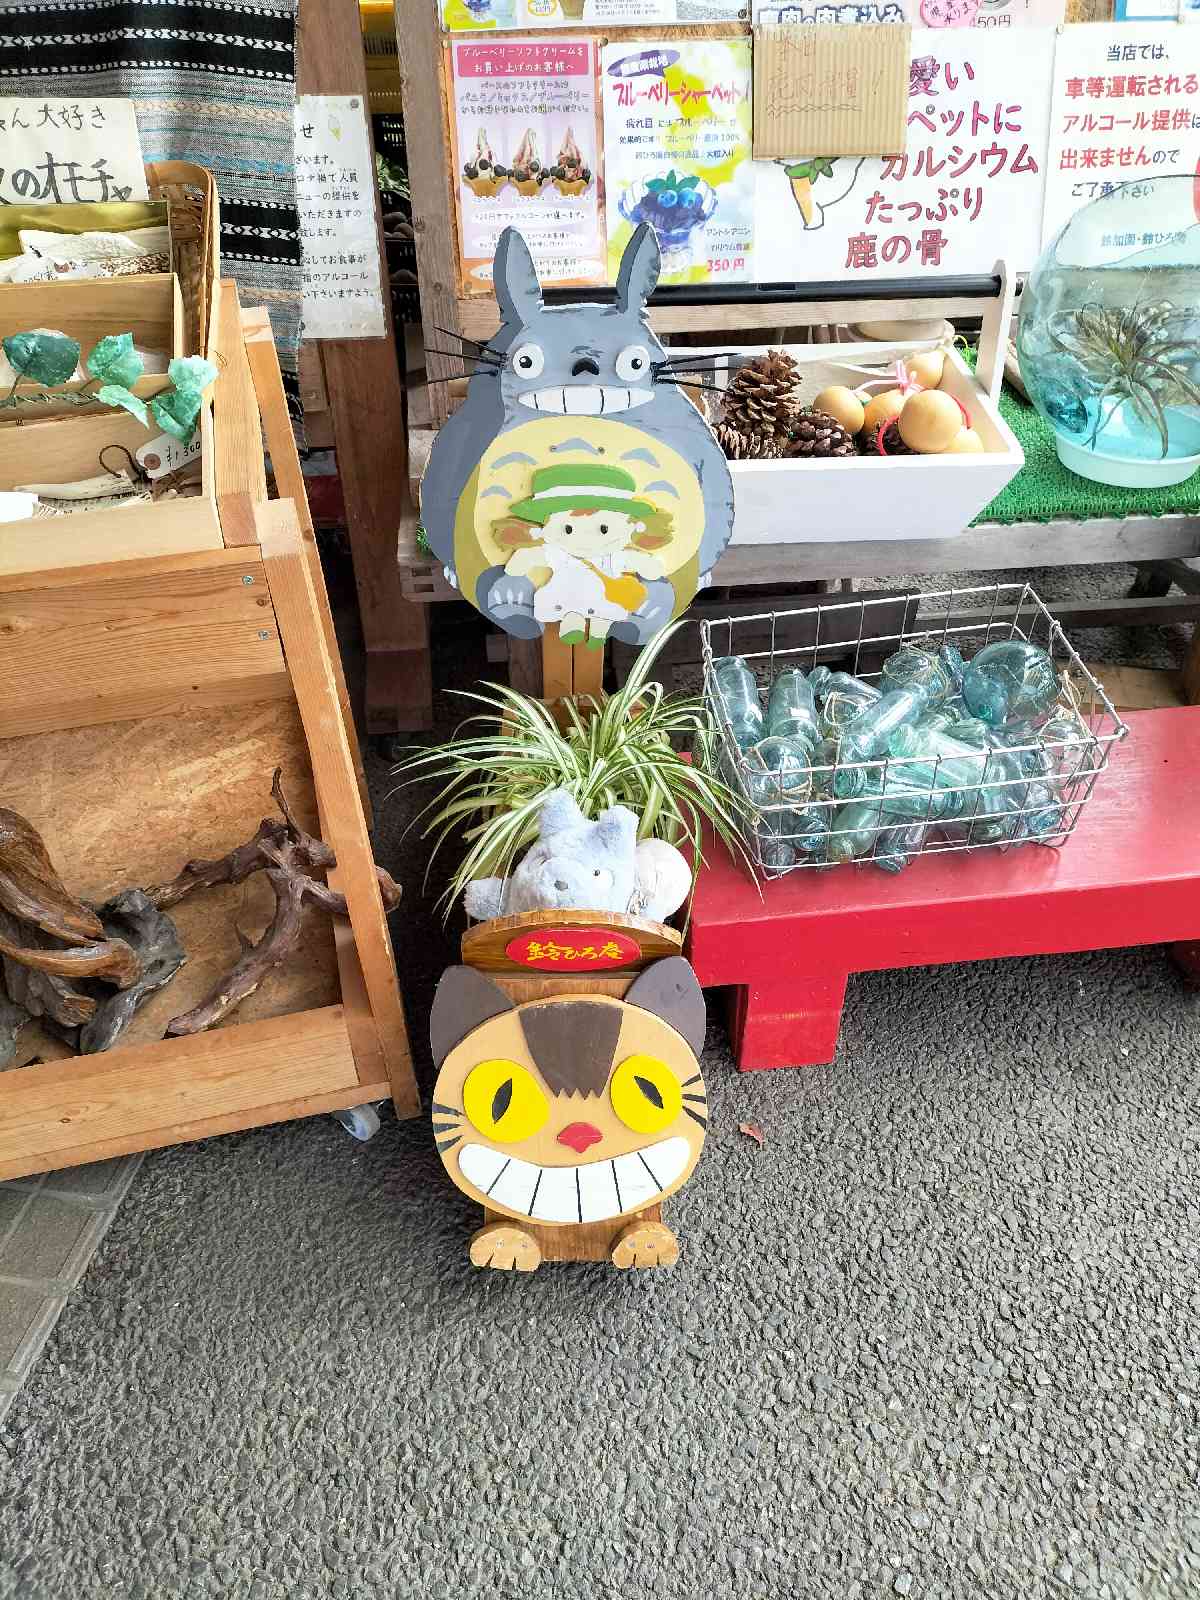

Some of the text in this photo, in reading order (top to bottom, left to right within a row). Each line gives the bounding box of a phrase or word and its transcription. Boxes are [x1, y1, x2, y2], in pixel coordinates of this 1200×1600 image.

[473, 62, 575, 74] お買い上げのお客様へ
[1065, 74, 1199, 99] 車等運転される
[300, 123, 315, 138] せ
[907, 101, 1022, 137] ペットに
[879, 142, 1038, 181] カルシウム
[1059, 146, 1180, 170] 出来ませんので
[1071, 179, 1154, 199] ご了承下さい
[865, 187, 983, 225] たっぷり
[845, 229, 949, 268] 鹿の骨
[527, 942, 625, 960] 鈴ひろ庵
